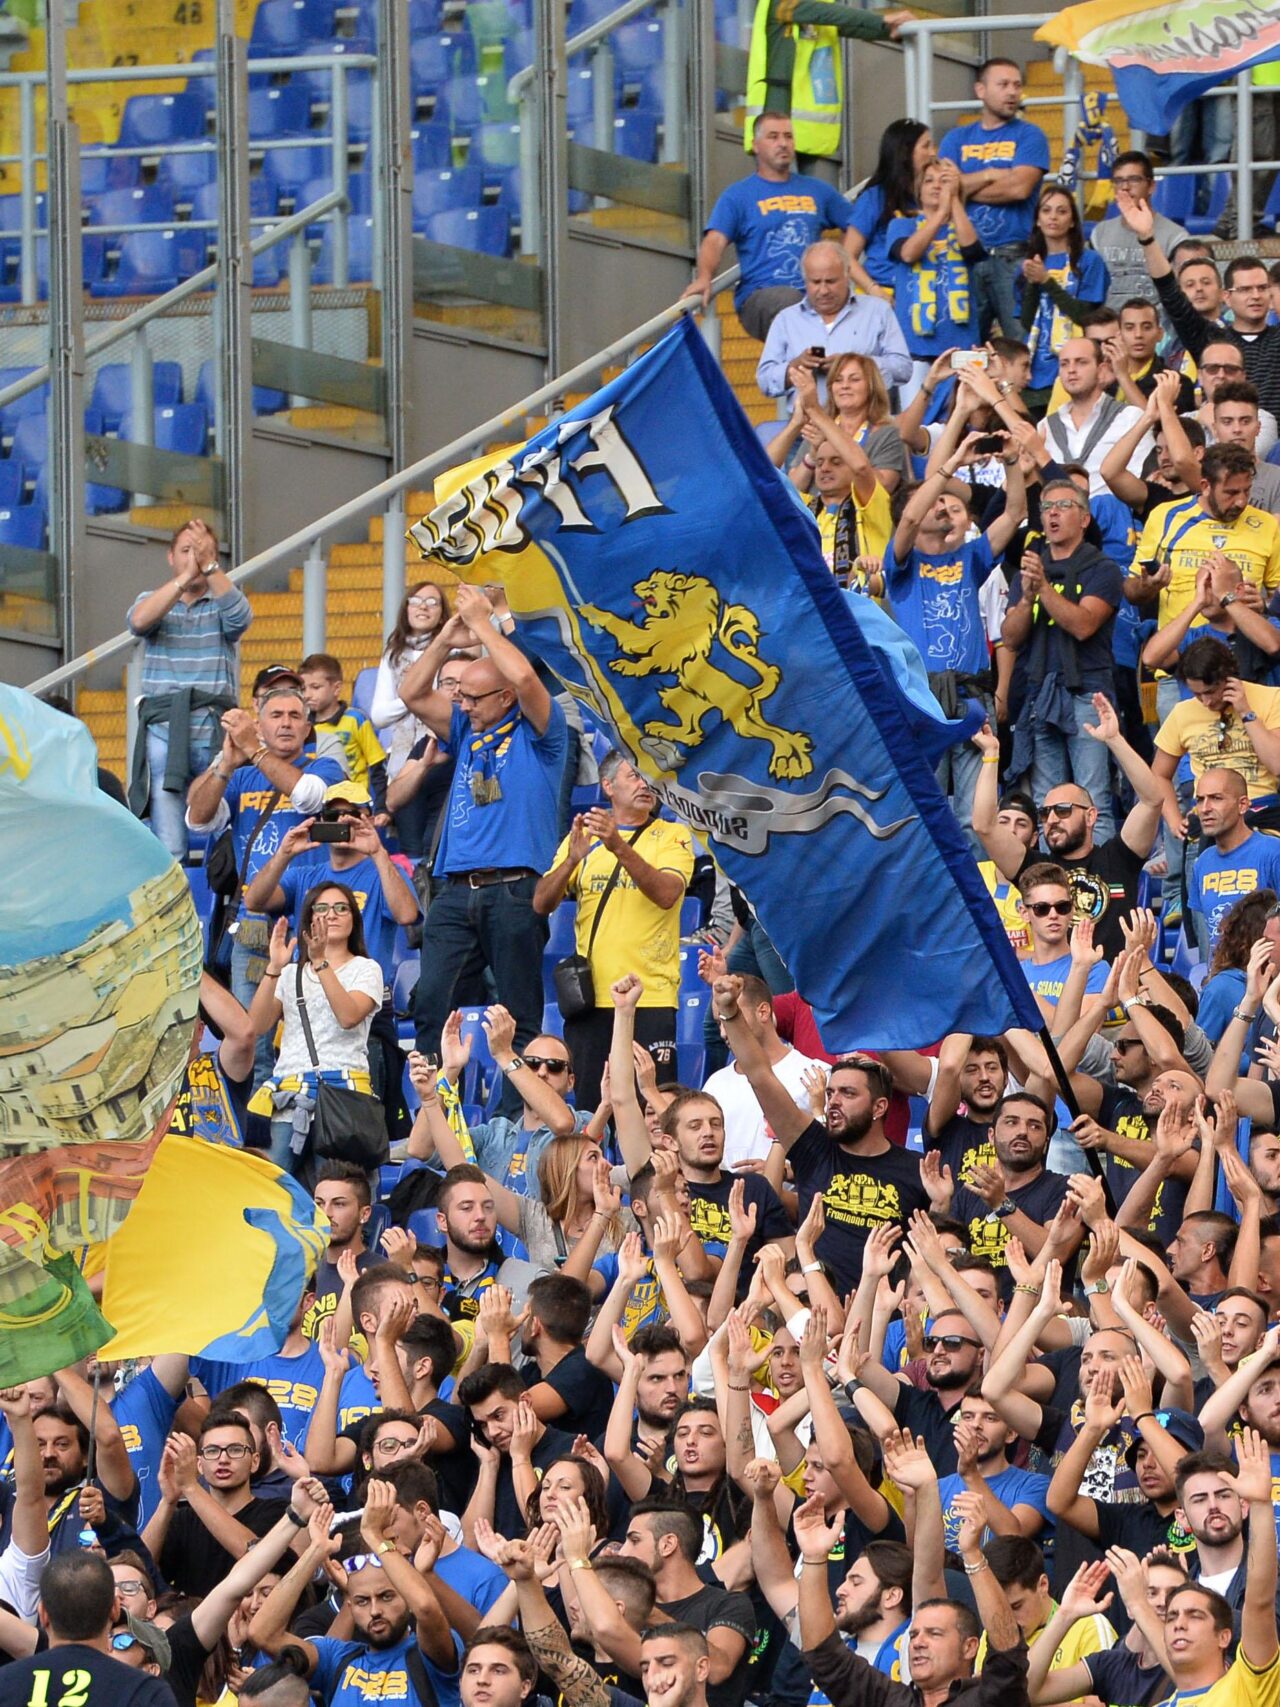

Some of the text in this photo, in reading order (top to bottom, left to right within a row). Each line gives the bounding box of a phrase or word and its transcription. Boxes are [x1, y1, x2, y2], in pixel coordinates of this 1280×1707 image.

[1202, 869, 1258, 896] 1928
[28, 1668, 92, 1707] 12
[342, 1665, 409, 1698] 1928
